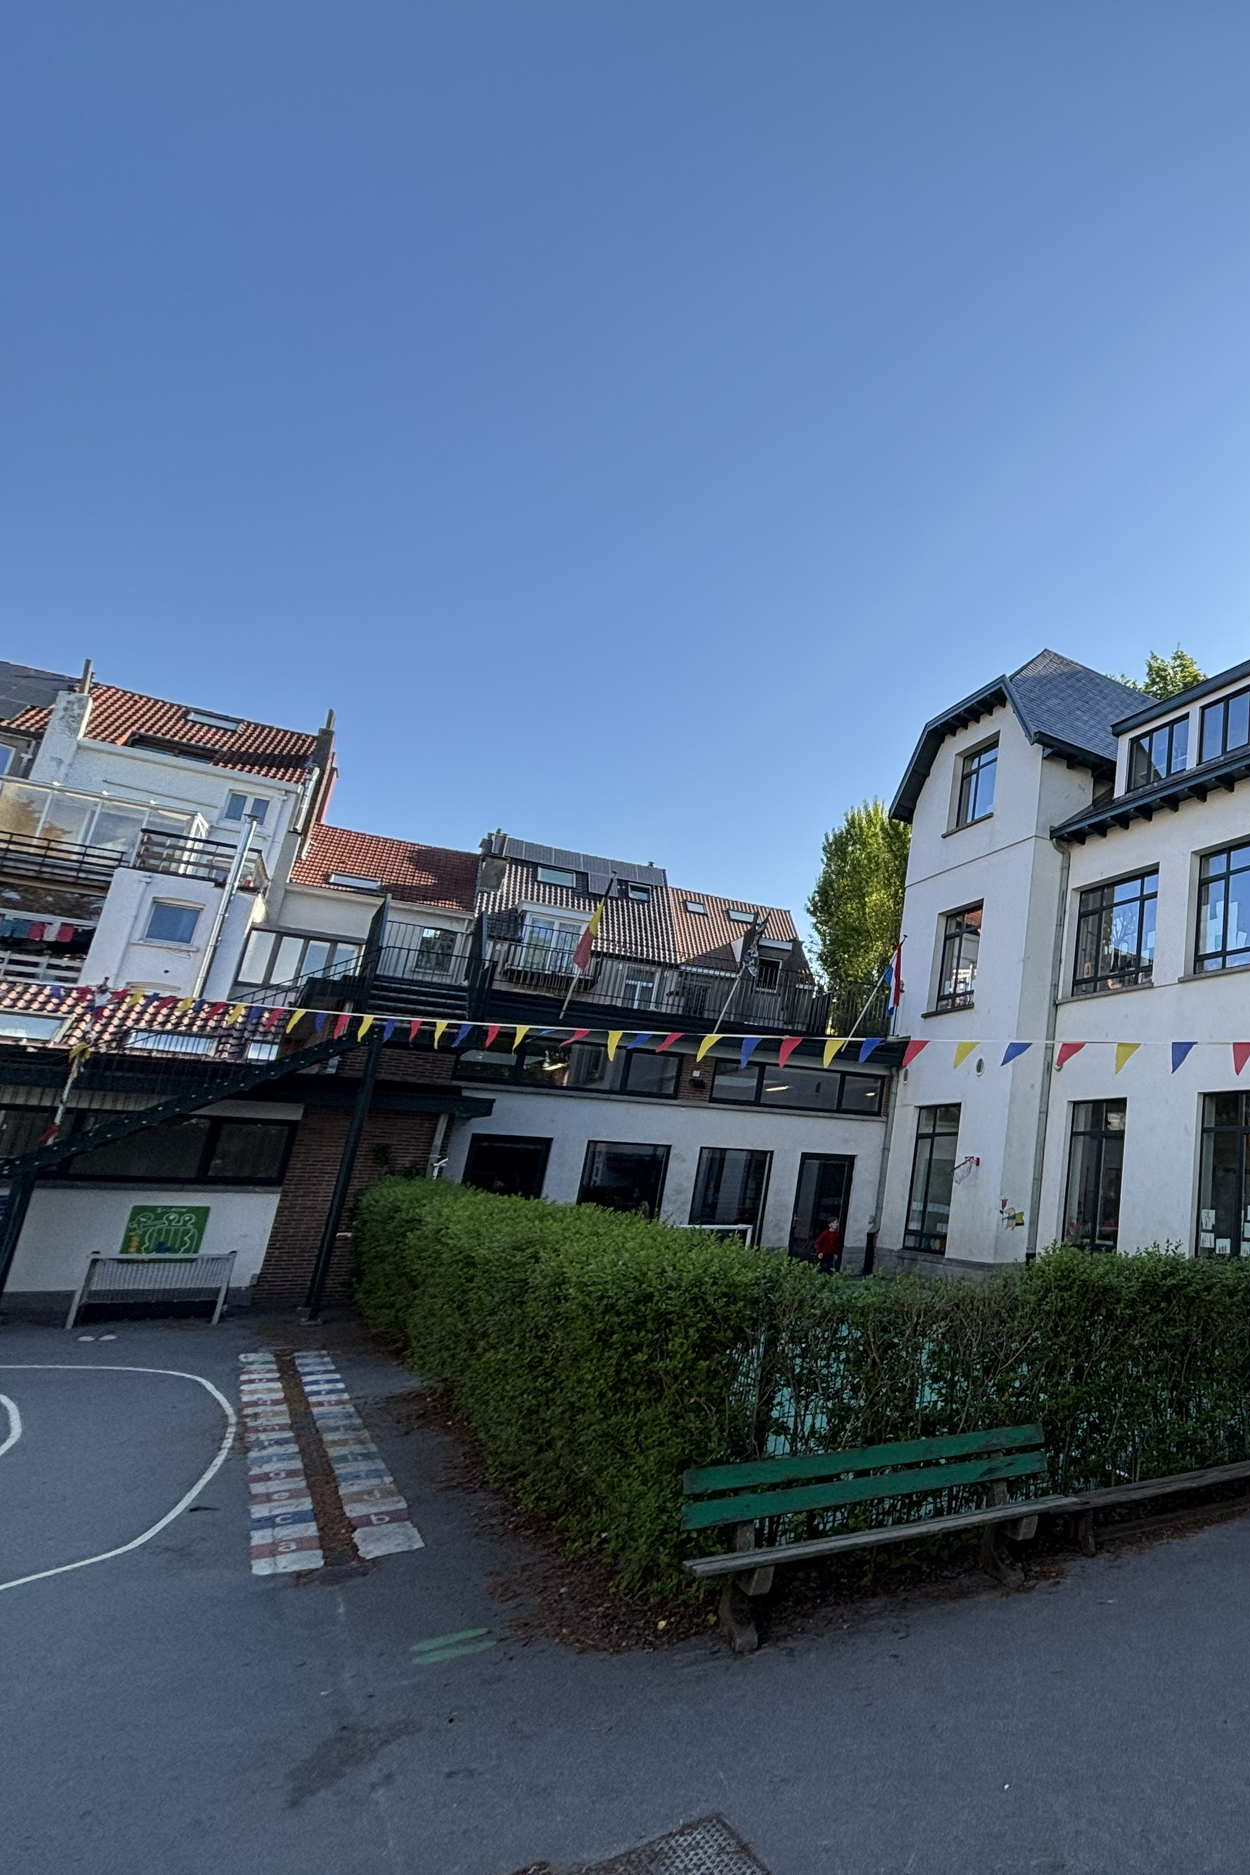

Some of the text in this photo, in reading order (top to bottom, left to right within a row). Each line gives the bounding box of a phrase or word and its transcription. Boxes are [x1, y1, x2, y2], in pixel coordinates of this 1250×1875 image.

[271, 1491, 290, 1500] e
[274, 1513, 293, 1525] c
[369, 1513, 390, 1525] b
[277, 1541, 298, 1552] a
